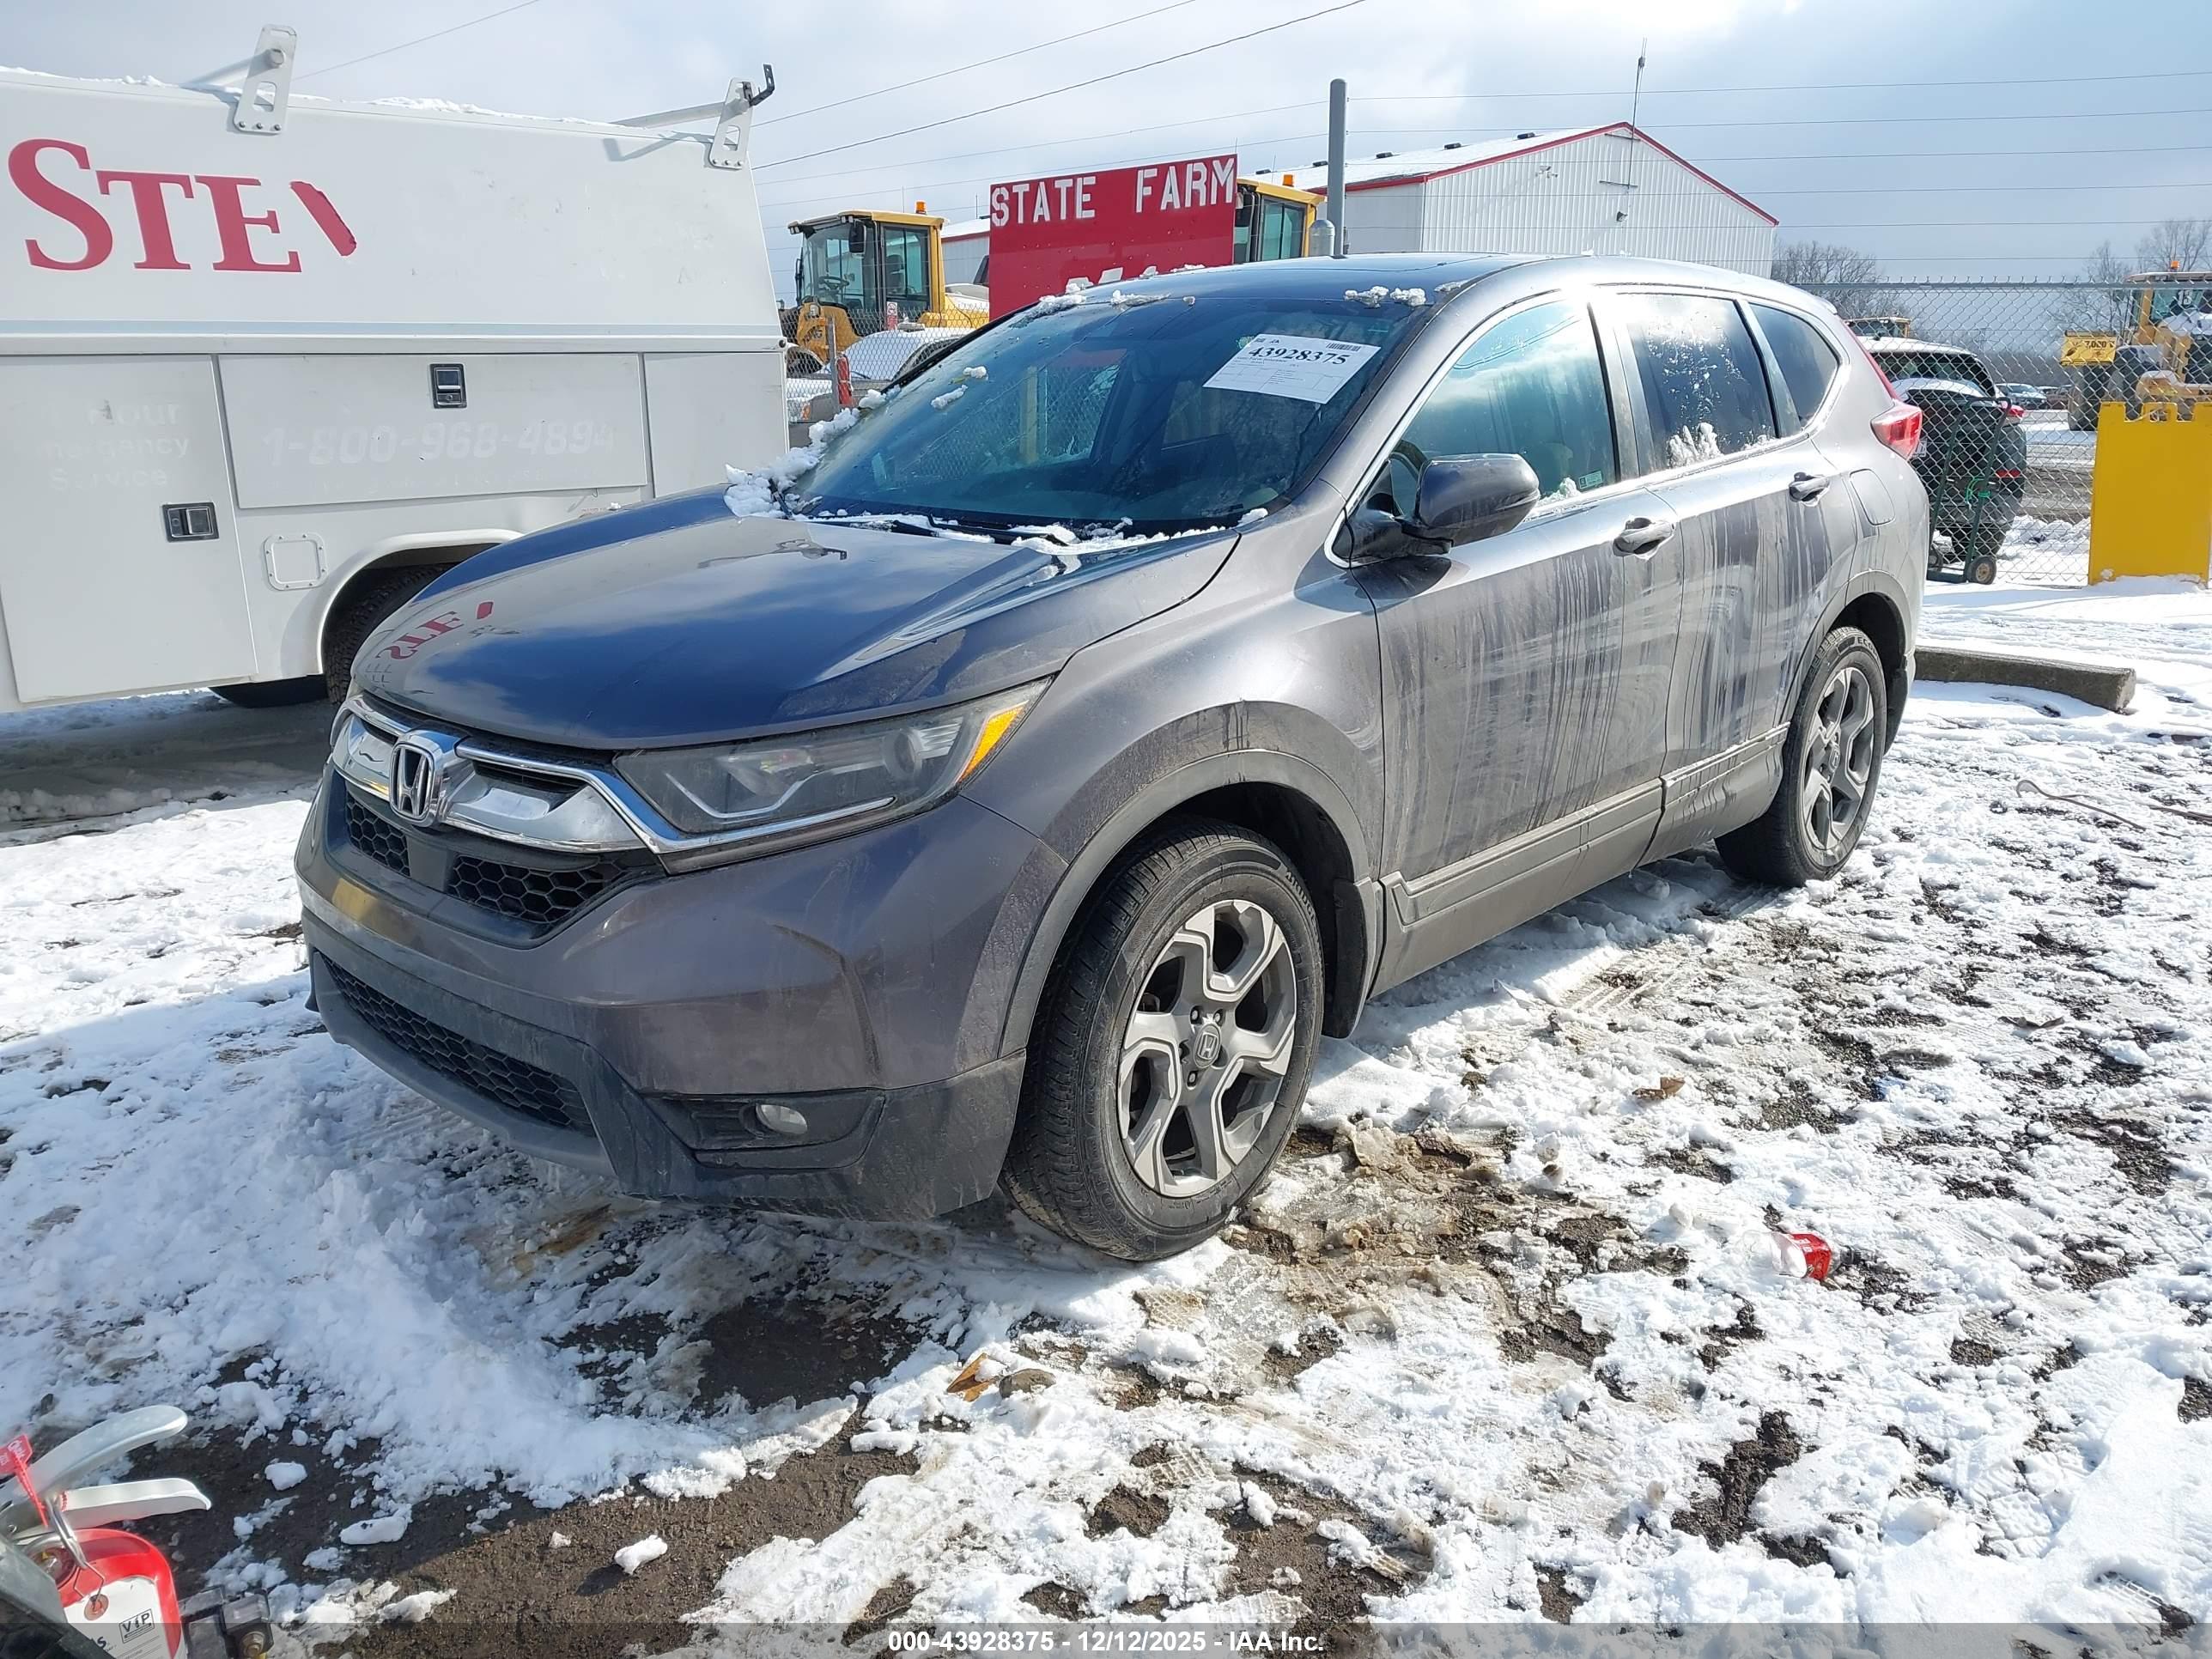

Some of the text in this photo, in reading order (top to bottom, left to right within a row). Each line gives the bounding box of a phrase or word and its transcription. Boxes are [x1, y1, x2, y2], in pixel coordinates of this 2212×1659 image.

[991, 157, 1235, 227] STATE FARM
[1249, 346, 1351, 365] 43928375
